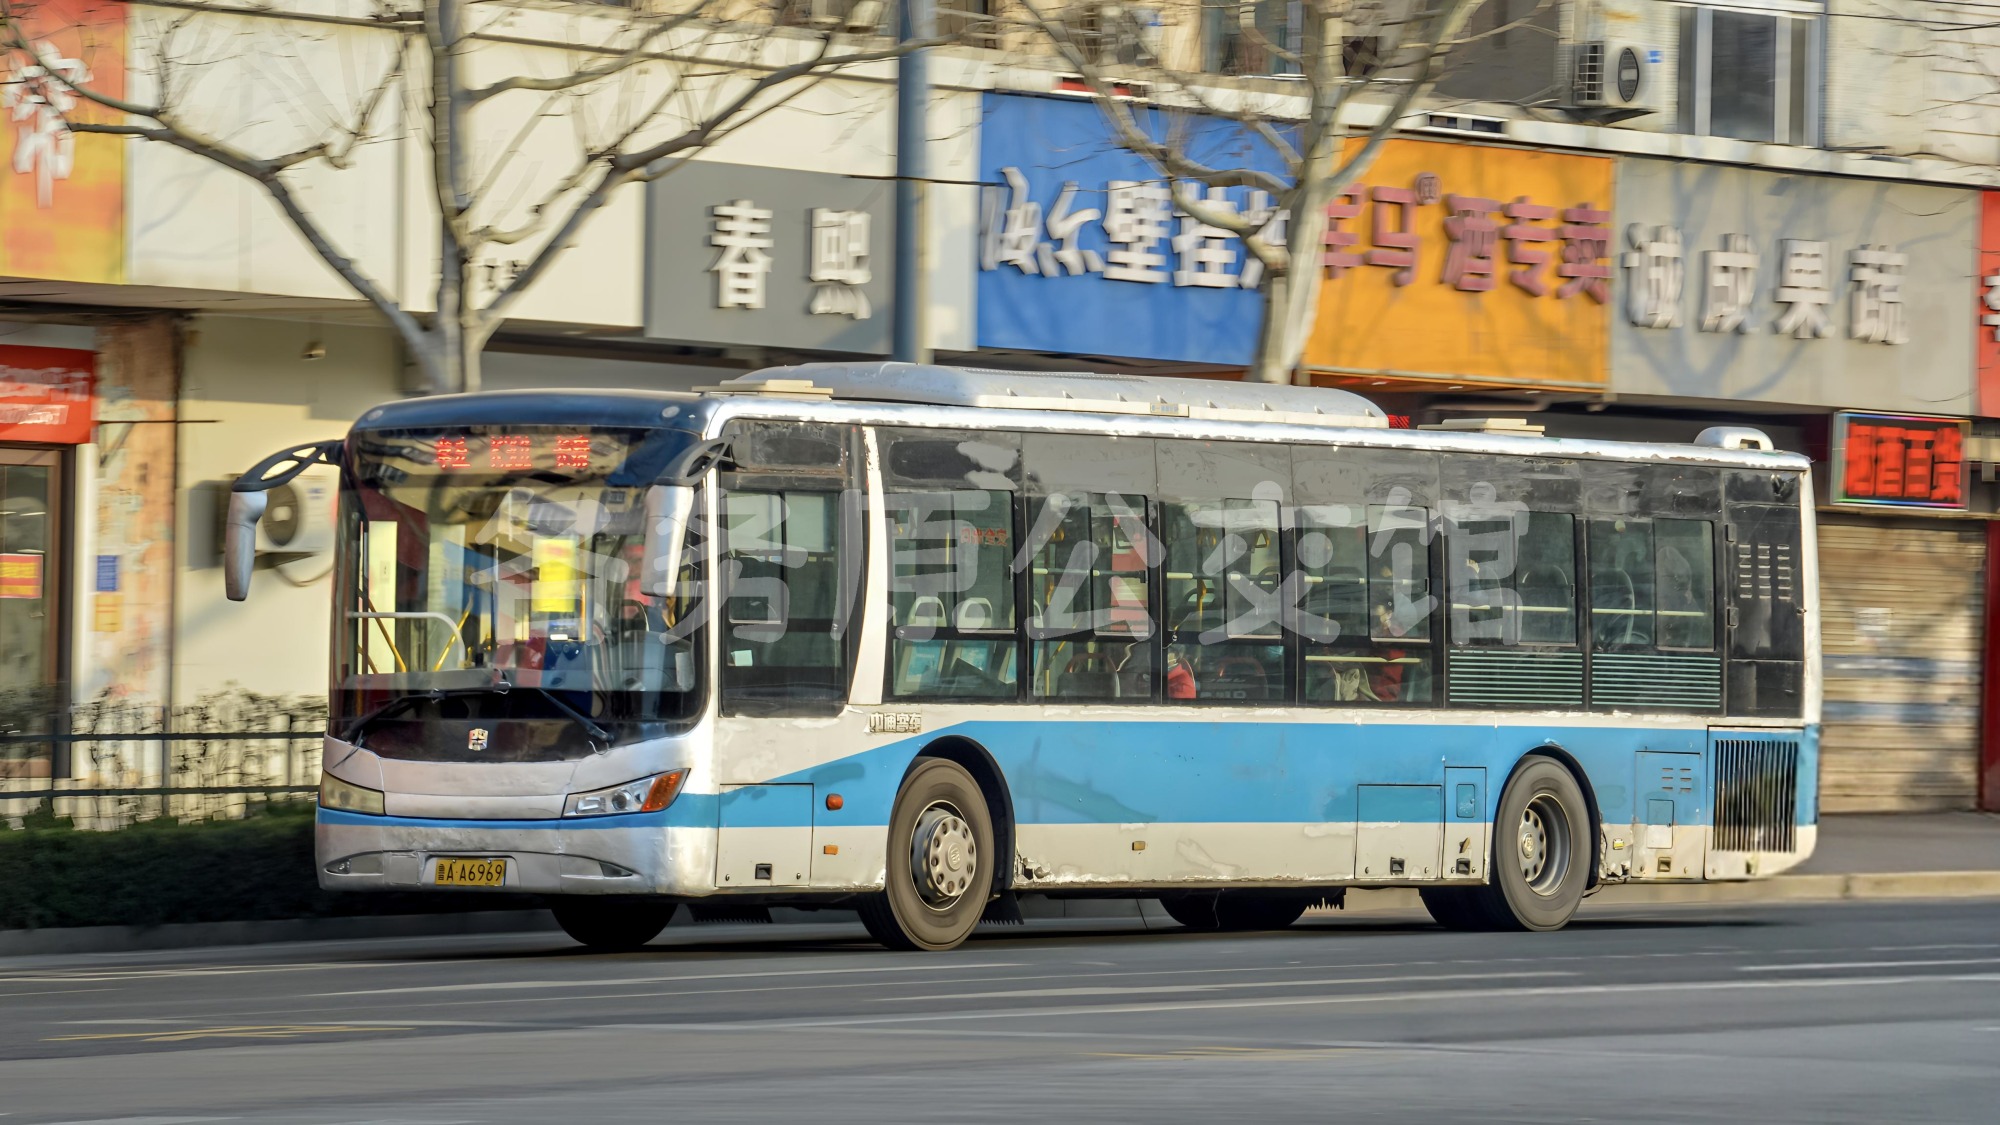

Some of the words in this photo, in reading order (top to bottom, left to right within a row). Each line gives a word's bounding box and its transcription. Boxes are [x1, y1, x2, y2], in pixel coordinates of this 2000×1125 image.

[711, 199, 872, 320] 春熙
[1620, 222, 1910, 345] 诚成果蔬
[870, 712, 922, 733] 中通客车
